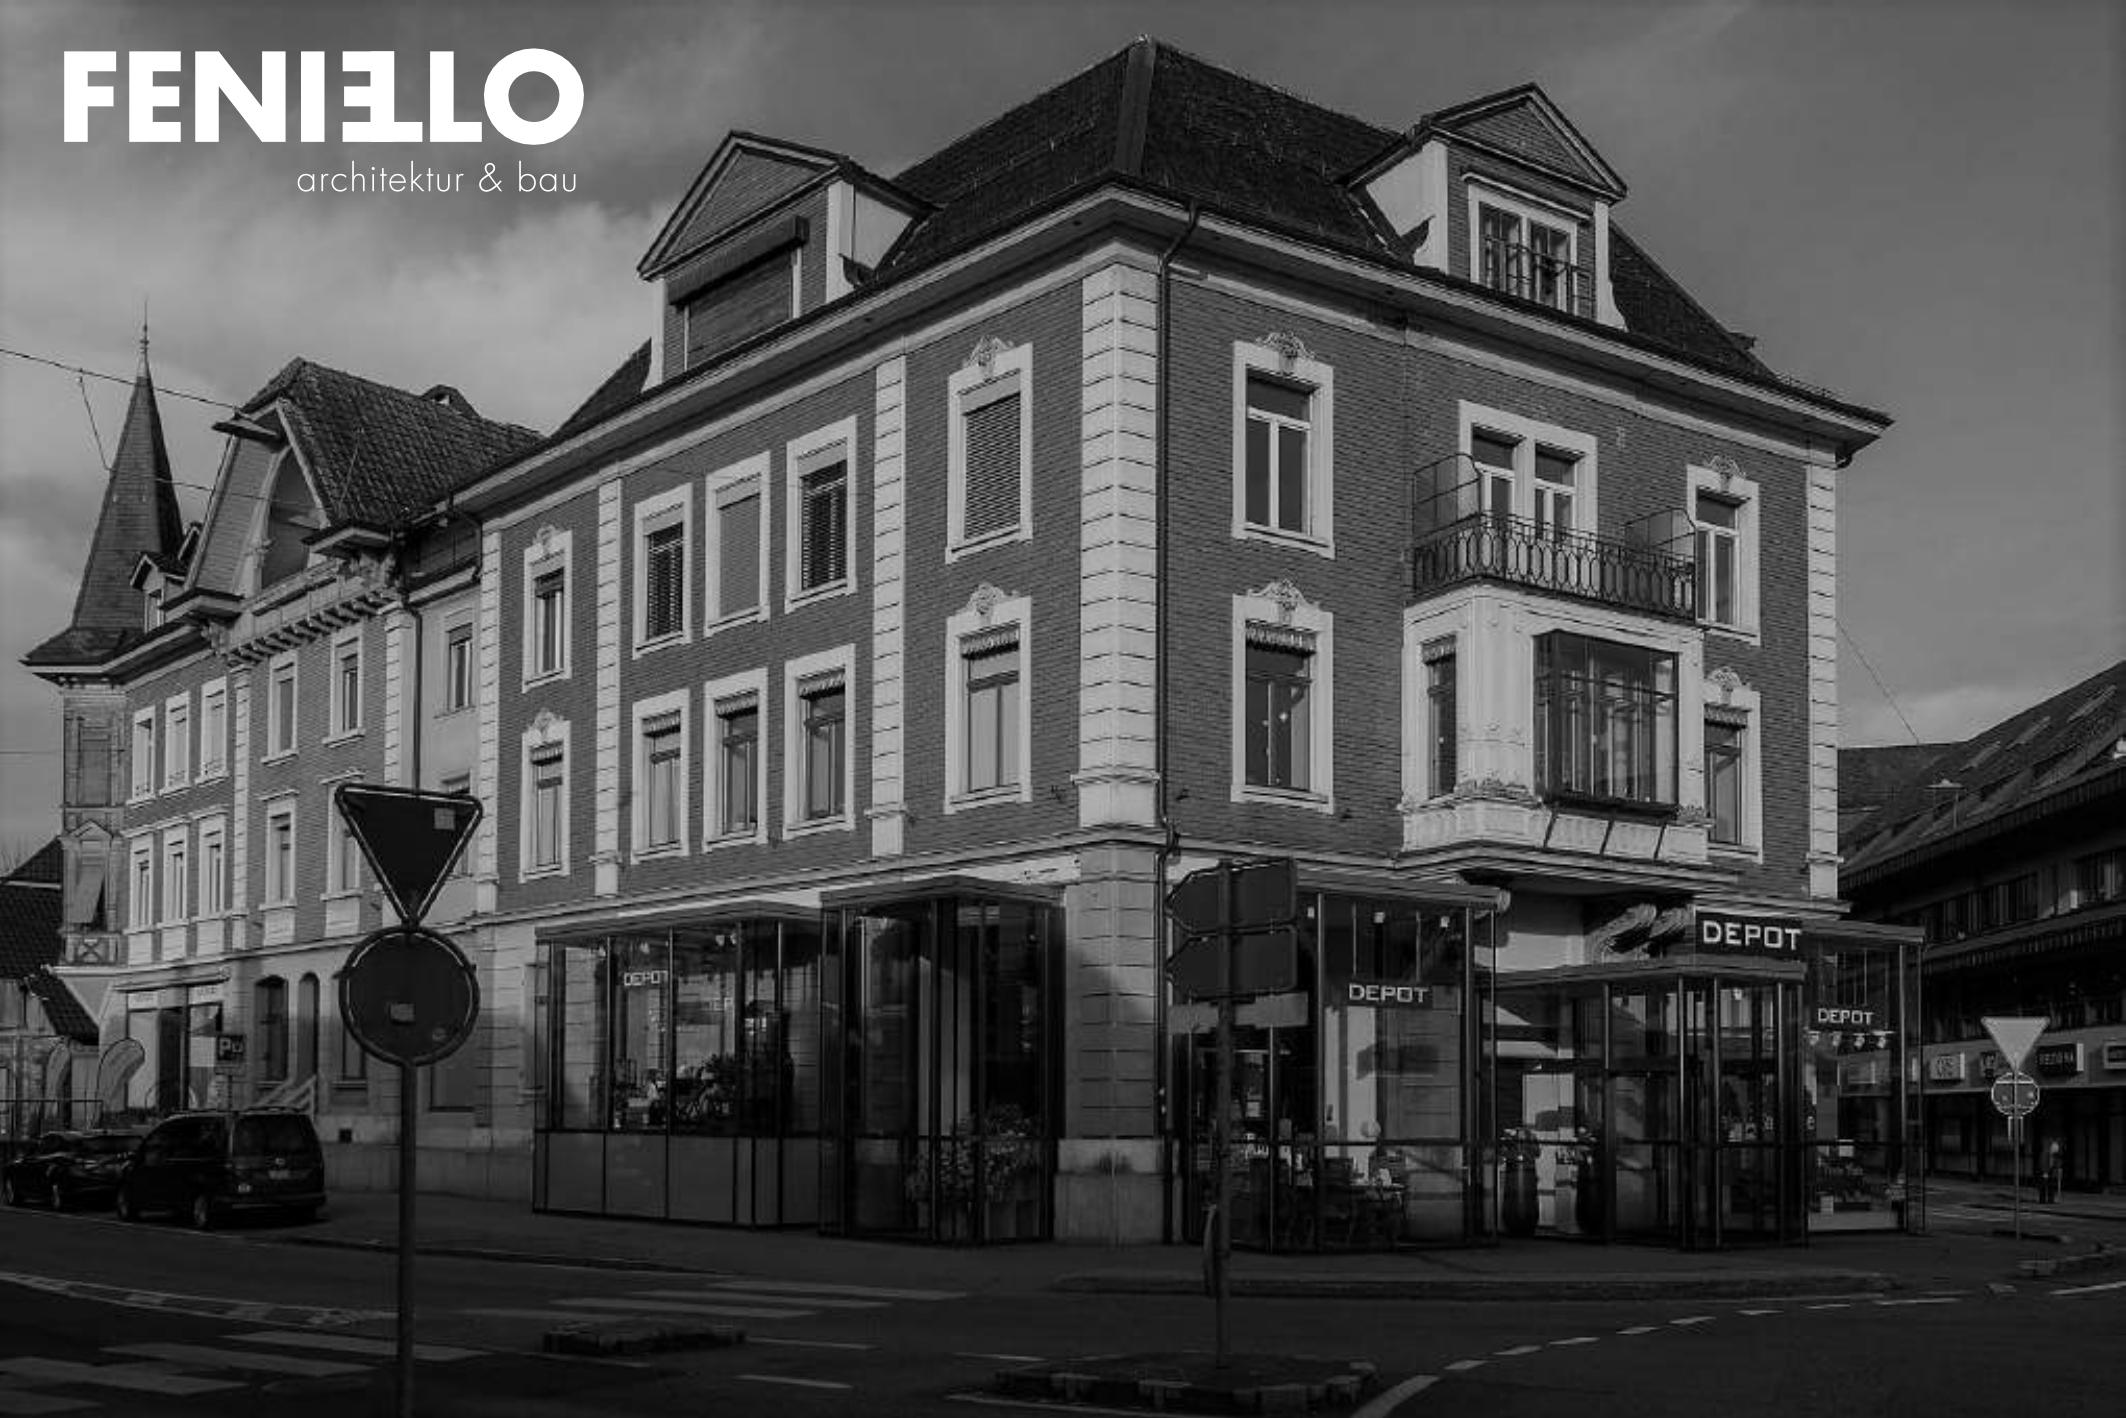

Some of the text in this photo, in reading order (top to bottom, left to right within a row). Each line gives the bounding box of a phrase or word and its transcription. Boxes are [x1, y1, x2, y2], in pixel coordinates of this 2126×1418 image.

[1702, 919, 1803, 951] DEPOT
[1348, 982, 1430, 1004] DEPOT
[1817, 1007, 1876, 1026] DEPOT
